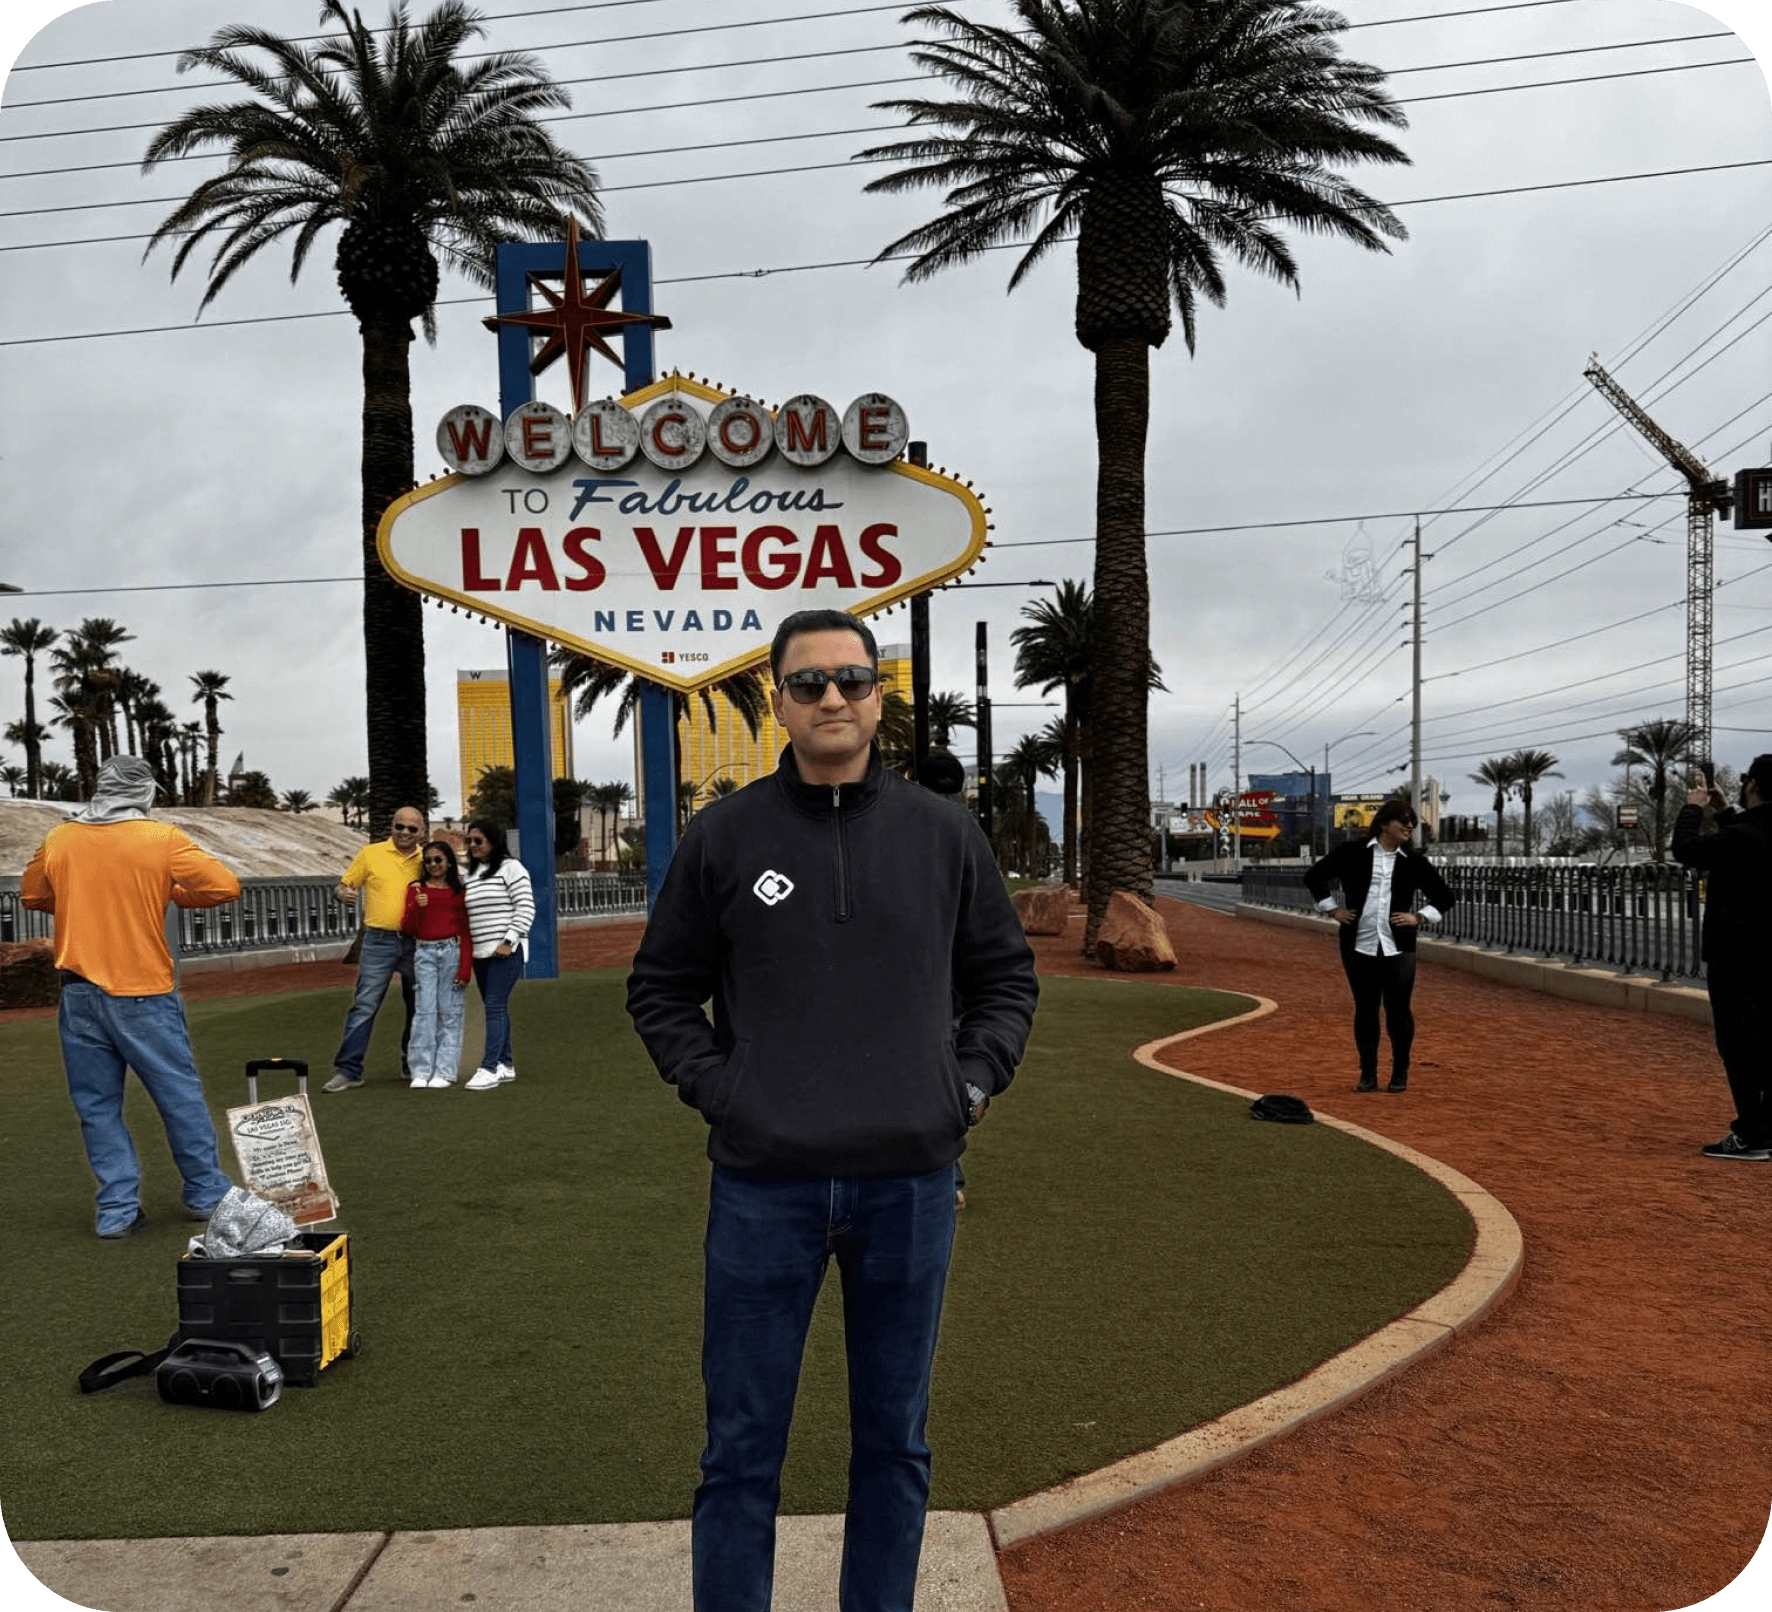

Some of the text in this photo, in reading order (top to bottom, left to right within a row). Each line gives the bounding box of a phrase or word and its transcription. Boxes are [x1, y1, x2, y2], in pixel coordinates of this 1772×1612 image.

[446, 408, 890, 463] WELCOME
[502, 476, 843, 521] TO Fabulous
[460, 522, 902, 592] LAS VEGAS
[594, 608, 763, 632] NEVADA
[678, 652, 709, 662] YESCO
[469, 671, 482, 681] W
